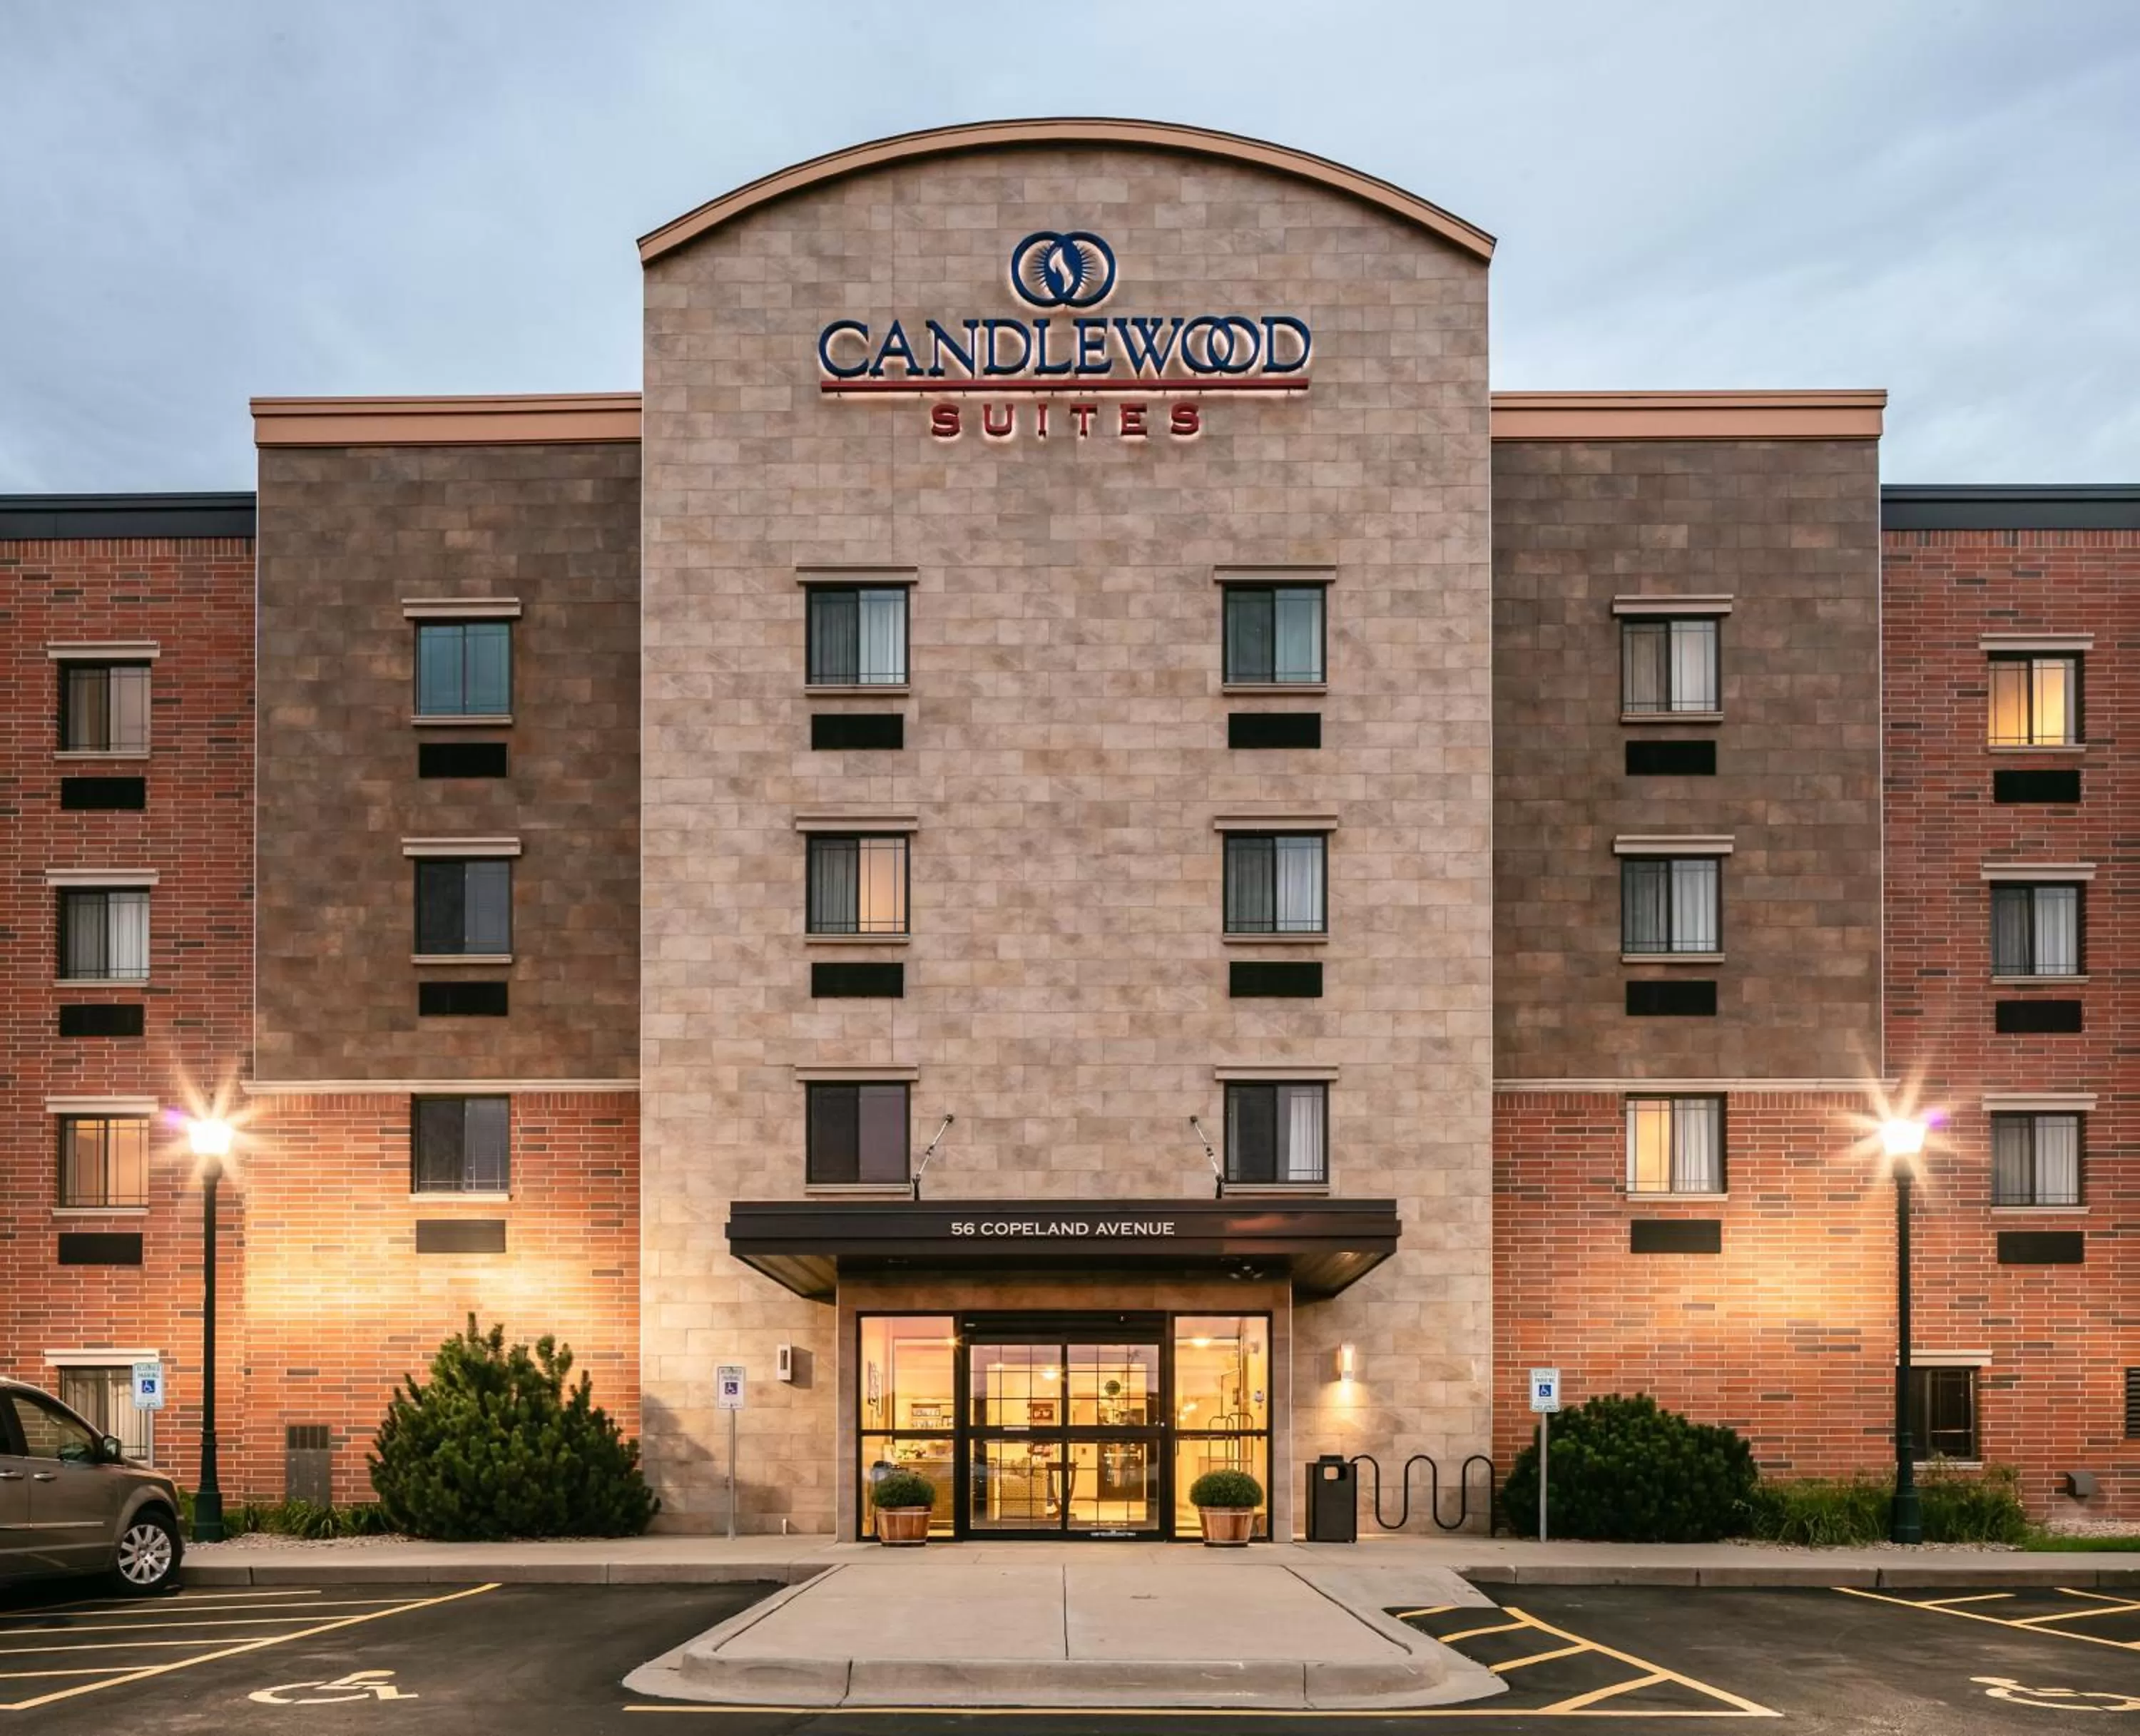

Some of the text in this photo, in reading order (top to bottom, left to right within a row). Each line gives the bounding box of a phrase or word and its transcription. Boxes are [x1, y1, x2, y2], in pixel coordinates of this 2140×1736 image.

[818, 316, 1312, 378] CANDLEWOOD
[931, 402, 1201, 437] SUITES
[951, 1222, 1176, 1235] 56 COPELAND AVENUE
